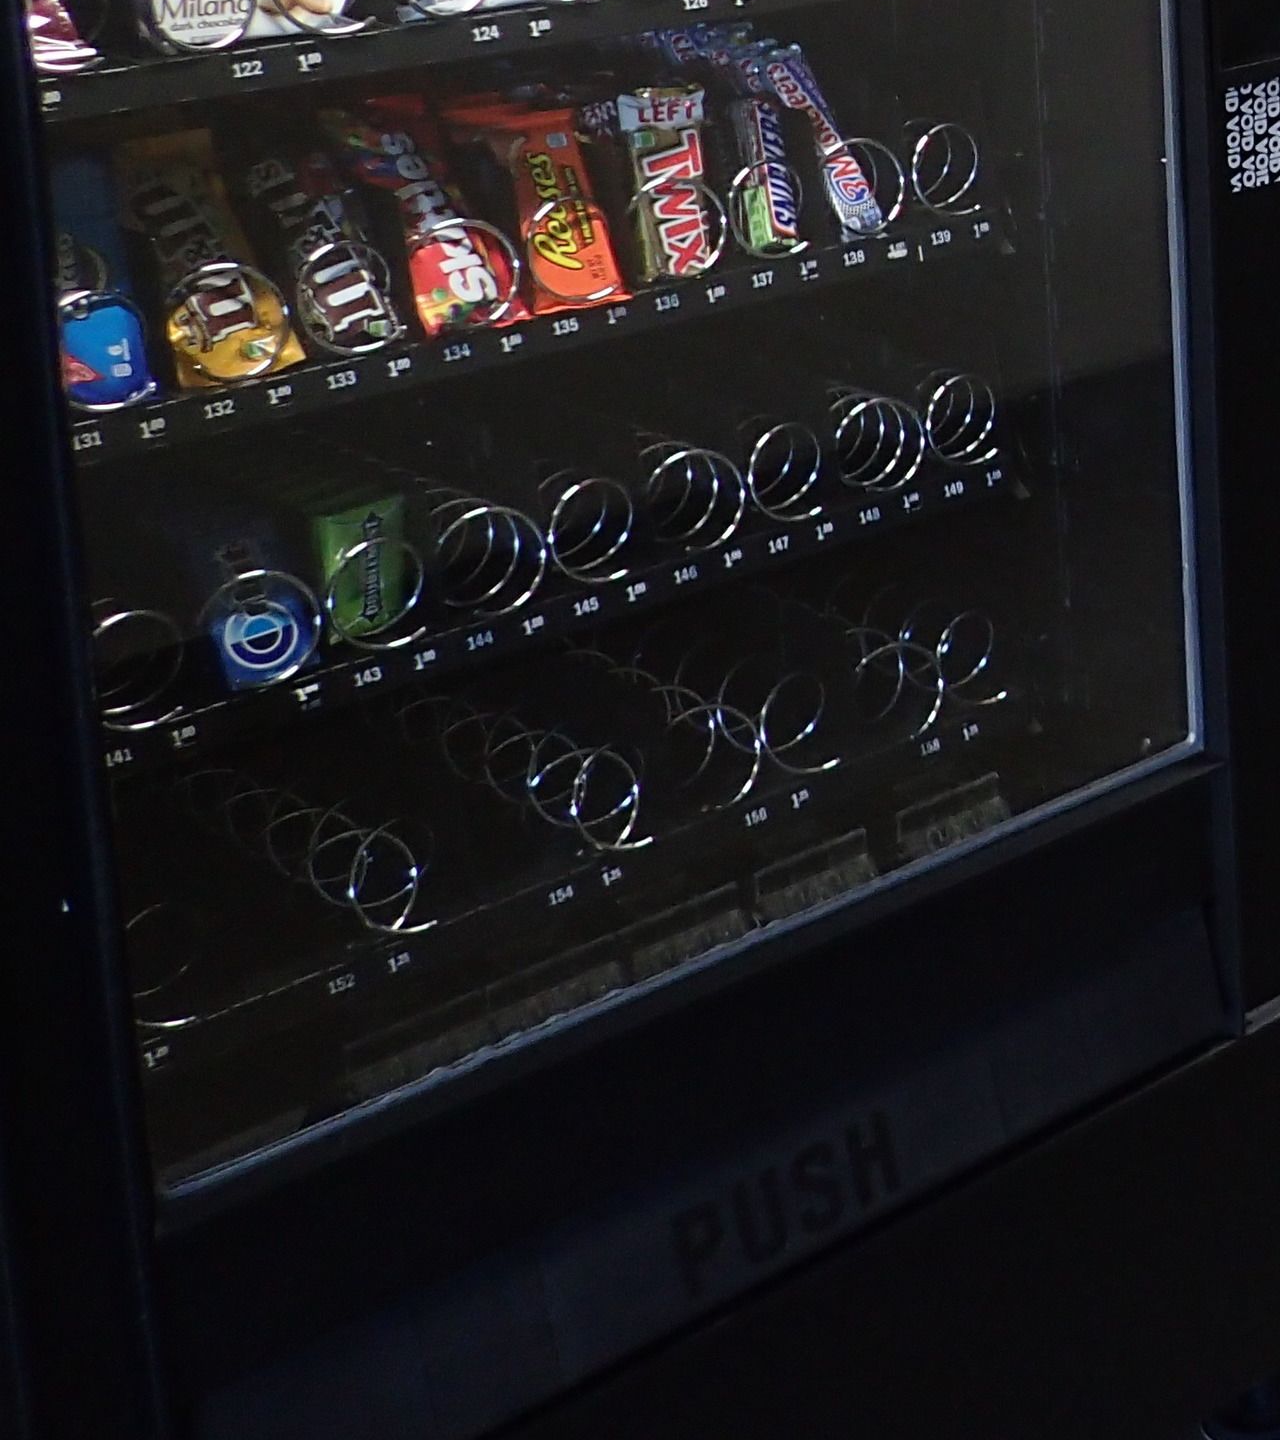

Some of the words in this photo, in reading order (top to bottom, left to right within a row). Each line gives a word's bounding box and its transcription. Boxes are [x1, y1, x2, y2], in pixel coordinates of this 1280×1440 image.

[471, 24, 501, 42] 124
[232, 60, 264, 78] 122
[638, 102, 697, 123] LEFT
[1253, 82, 1267, 135] VOID
[1240, 99, 1254, 151] VOID
[1226, 115, 1241, 168] VOID
[641, 127, 711, 276] TWIX
[930, 229, 951, 246] 139
[843, 249, 866, 267] 138
[751, 270, 774, 288] 137
[552, 317, 579, 336] 135
[443, 343, 472, 362] 134
[326, 370, 357, 390] 133
[203, 399, 236, 419] 132
[73, 430, 103, 451] 131
[944, 480, 964, 498] 149
[768, 535, 789, 554] 147
[573, 596, 600, 616] 145
[466, 630, 494, 651] 144
[354, 666, 383, 687] 143
[106, 748, 133, 767] 141
[548, 884, 574, 906] 154
[328, 973, 356, 995] 152
[671, 1109, 900, 1300] PUSH
